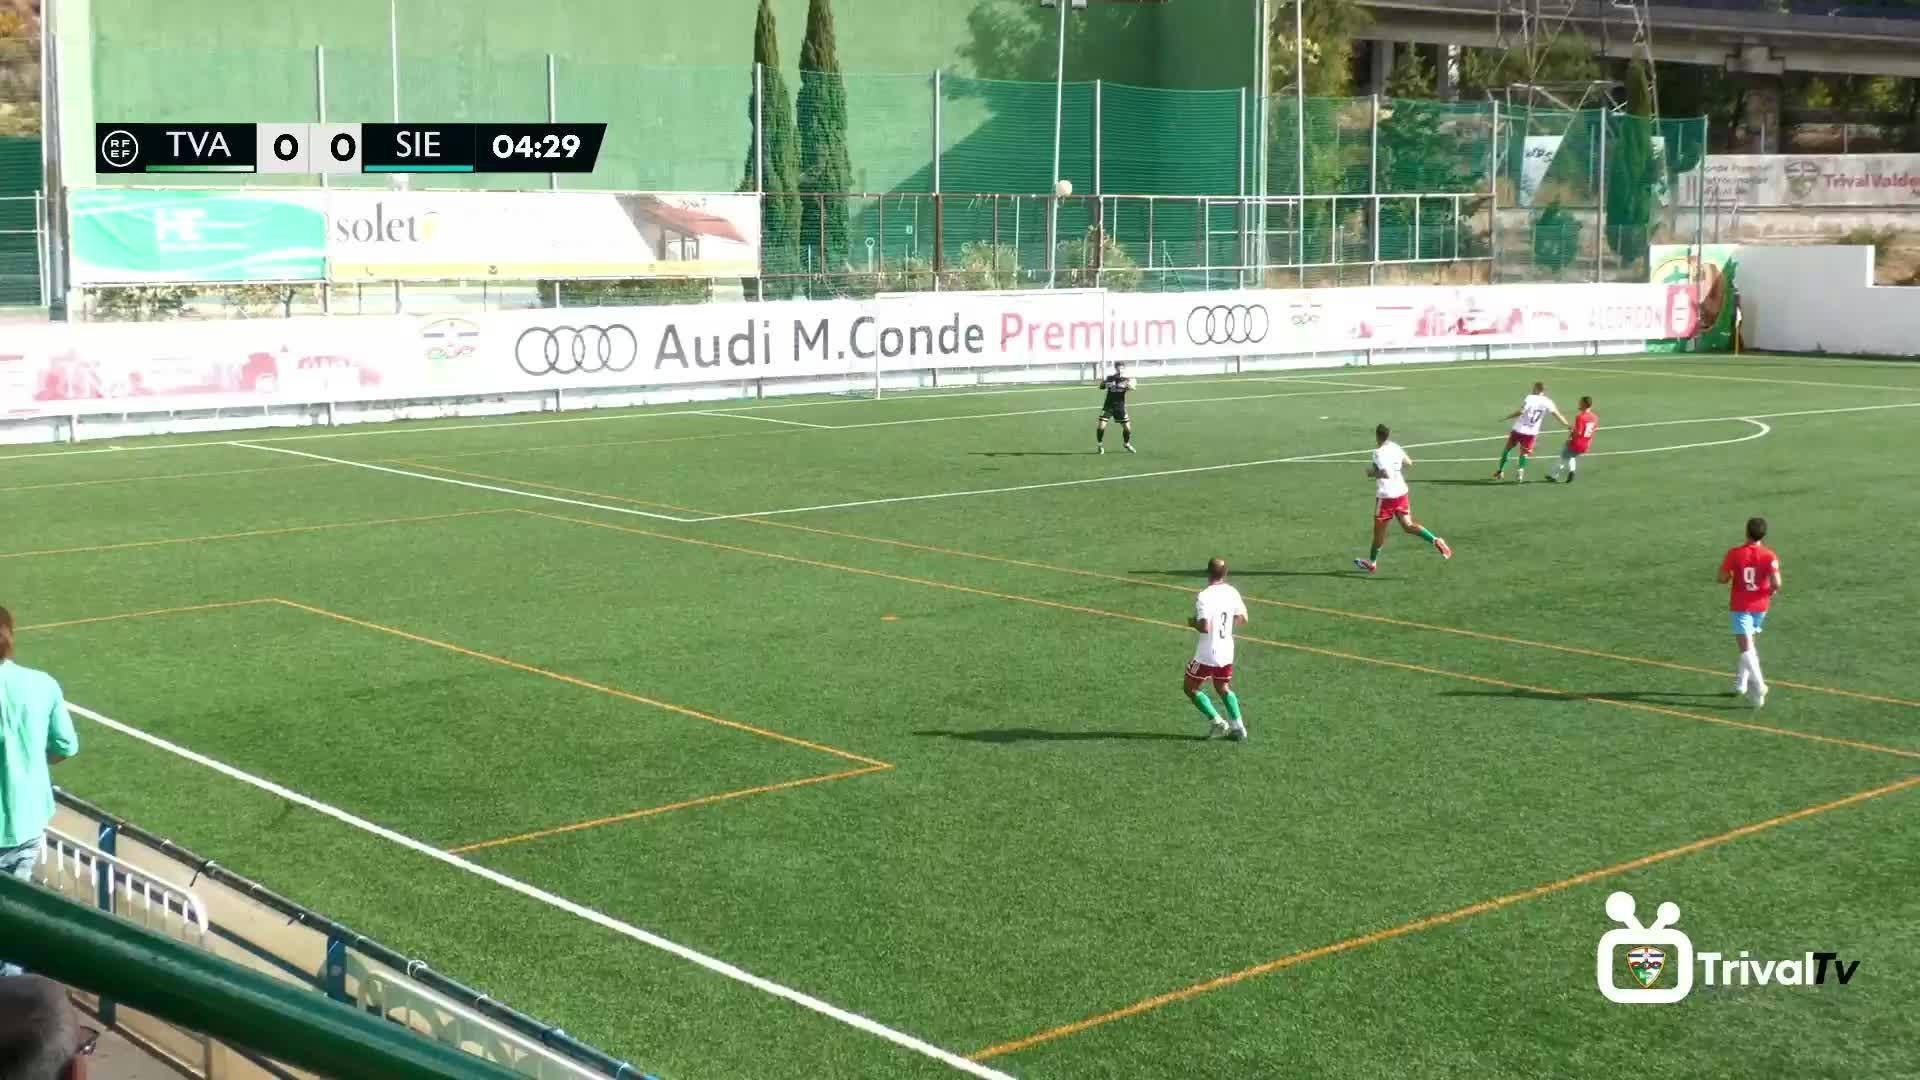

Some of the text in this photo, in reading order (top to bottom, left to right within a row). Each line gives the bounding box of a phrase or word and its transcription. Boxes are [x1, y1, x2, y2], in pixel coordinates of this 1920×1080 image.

[654, 309, 1176, 370] Audi M.Conde Premium
[1743, 567, 1760, 592] 9
[1219, 611, 1228, 639] 3
